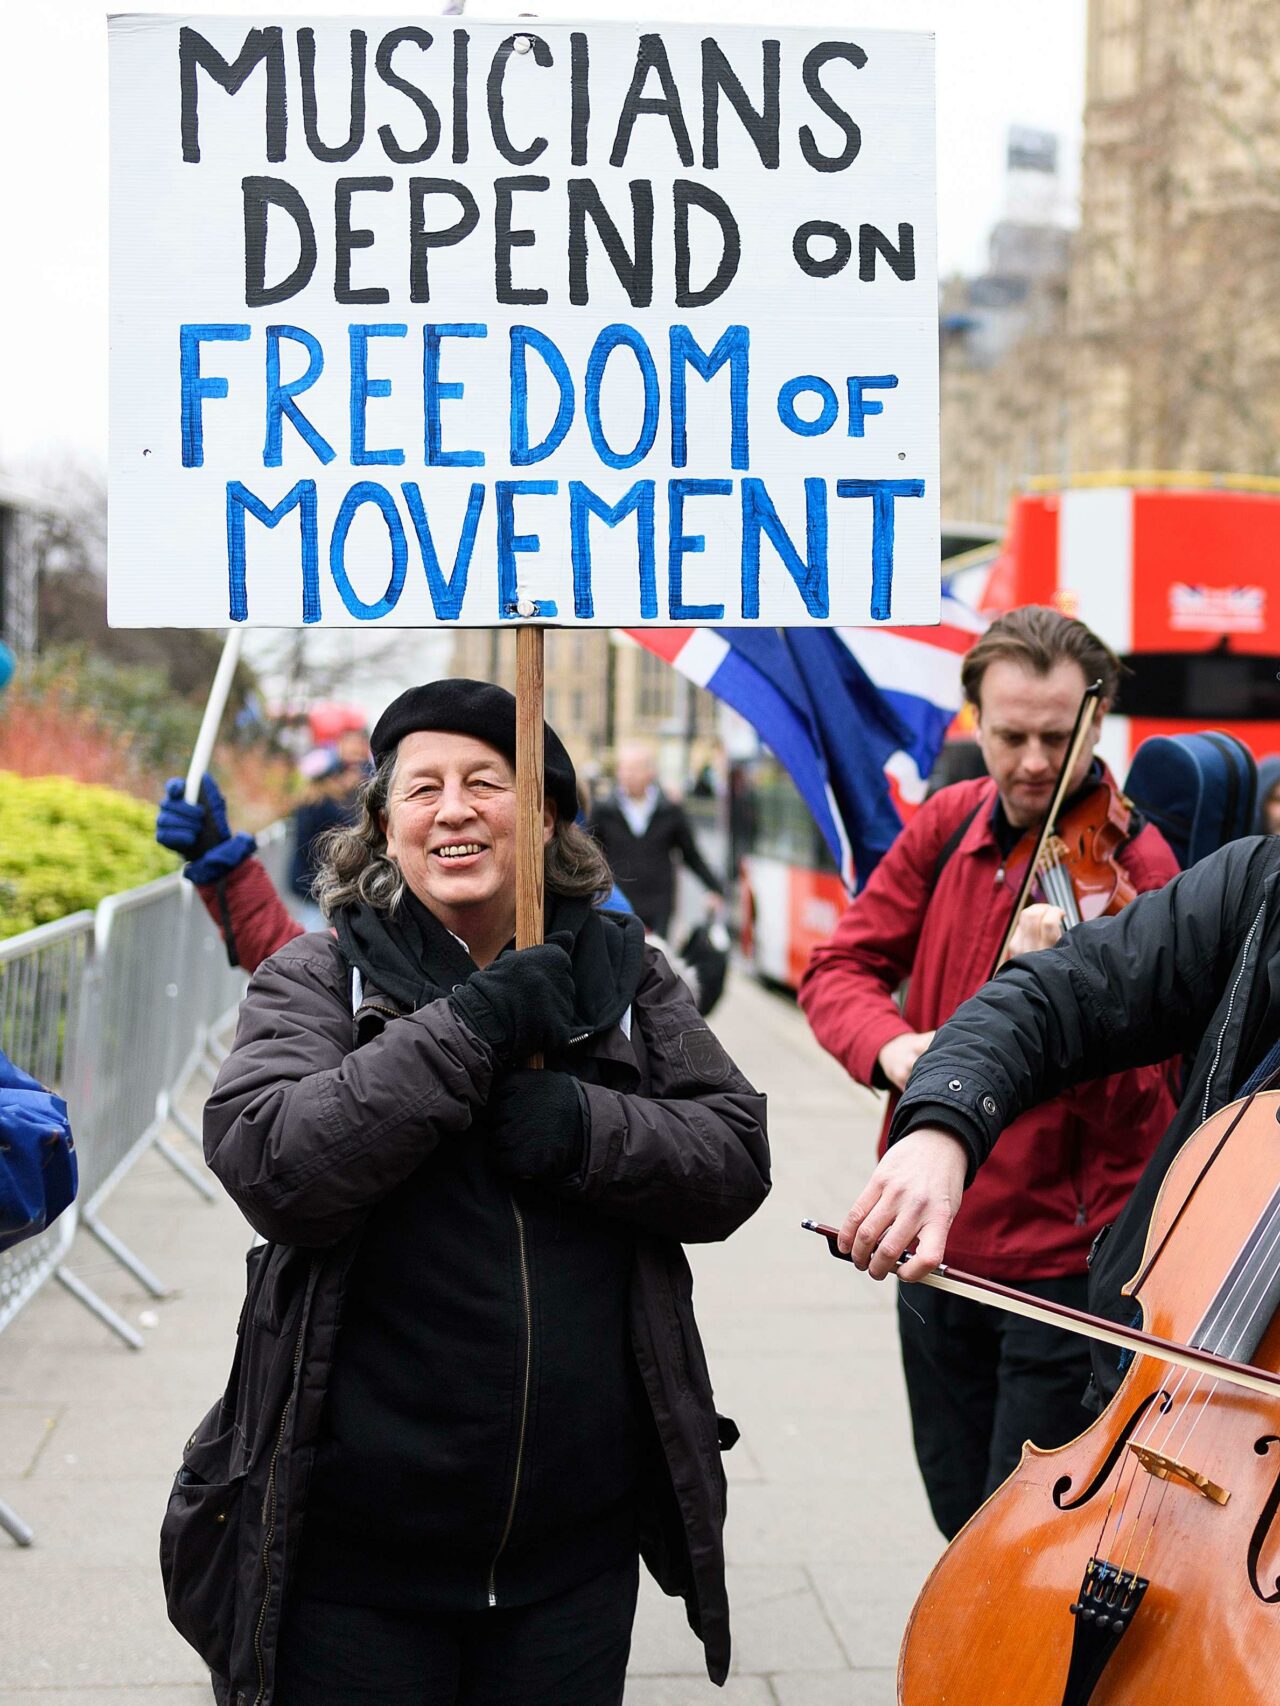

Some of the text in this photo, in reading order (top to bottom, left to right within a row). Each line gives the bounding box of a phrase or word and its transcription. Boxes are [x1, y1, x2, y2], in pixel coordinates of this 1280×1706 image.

[179, 26, 868, 172] MUSICIANS
[241, 175, 916, 307] DEPEND ON
[179, 324, 899, 470] FREEDOM OF
[226, 478, 925, 623] MOVEMENT
